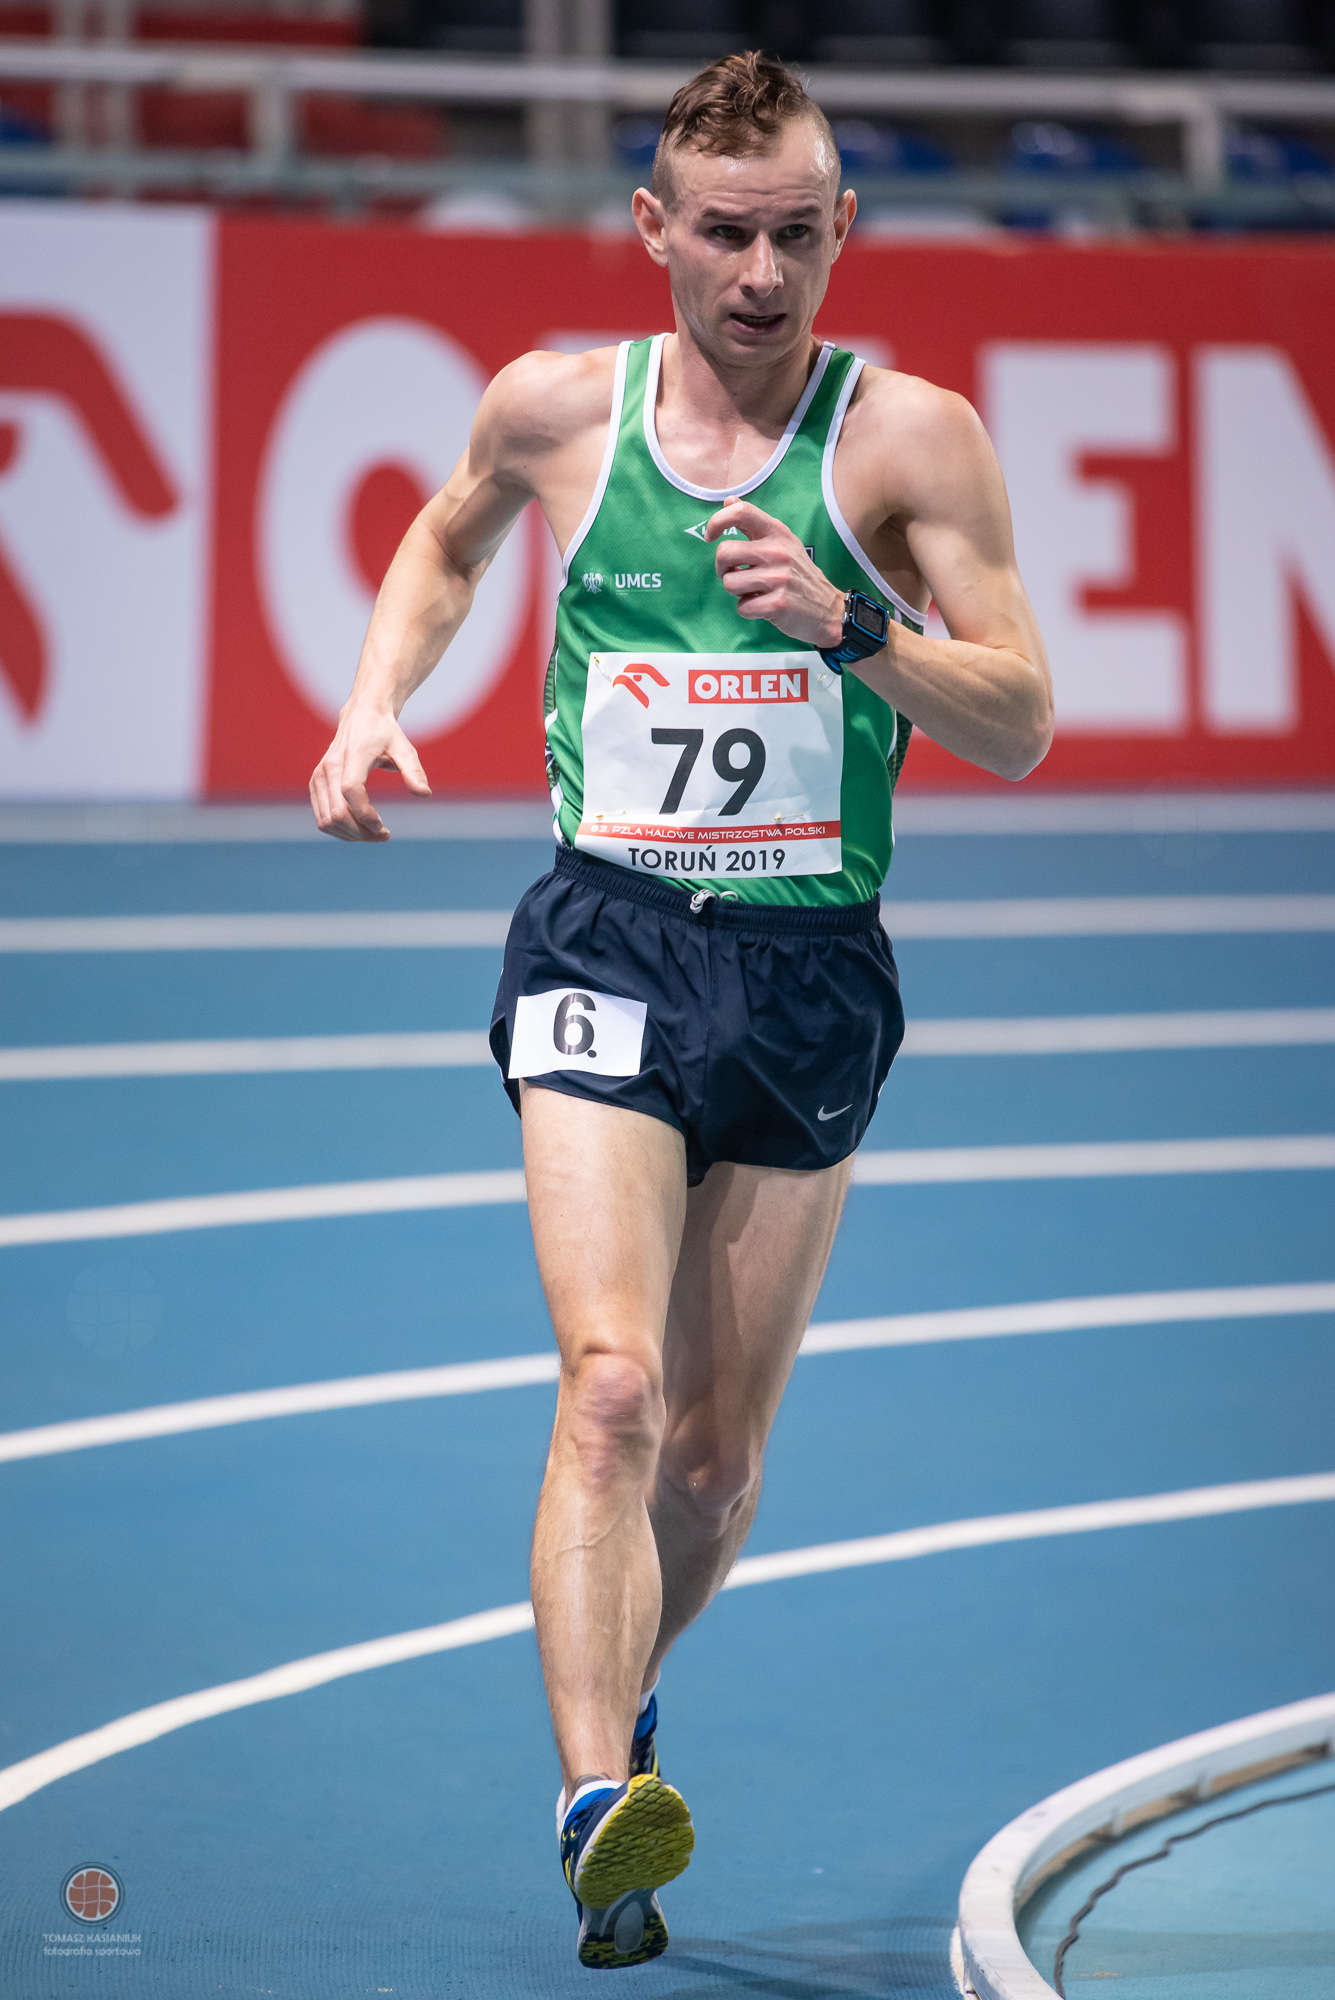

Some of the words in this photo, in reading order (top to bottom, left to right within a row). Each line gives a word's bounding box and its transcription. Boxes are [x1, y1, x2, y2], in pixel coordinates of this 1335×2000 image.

[615, 573, 662, 588] UMCS
[694, 673, 801, 699] ORLEN
[651, 728, 766, 816] 79
[590, 825, 610, 834] 63.
[612, 825, 643, 836] PZLA
[645, 828, 694, 840] HALOWE
[697, 828, 783, 840] MISTRZOSTWA
[785, 826, 826, 836] POLSKI
[628, 845, 716, 872] TORUŃ
[725, 848, 786, 872] 2019
[552, 992, 598, 1059] 6.
